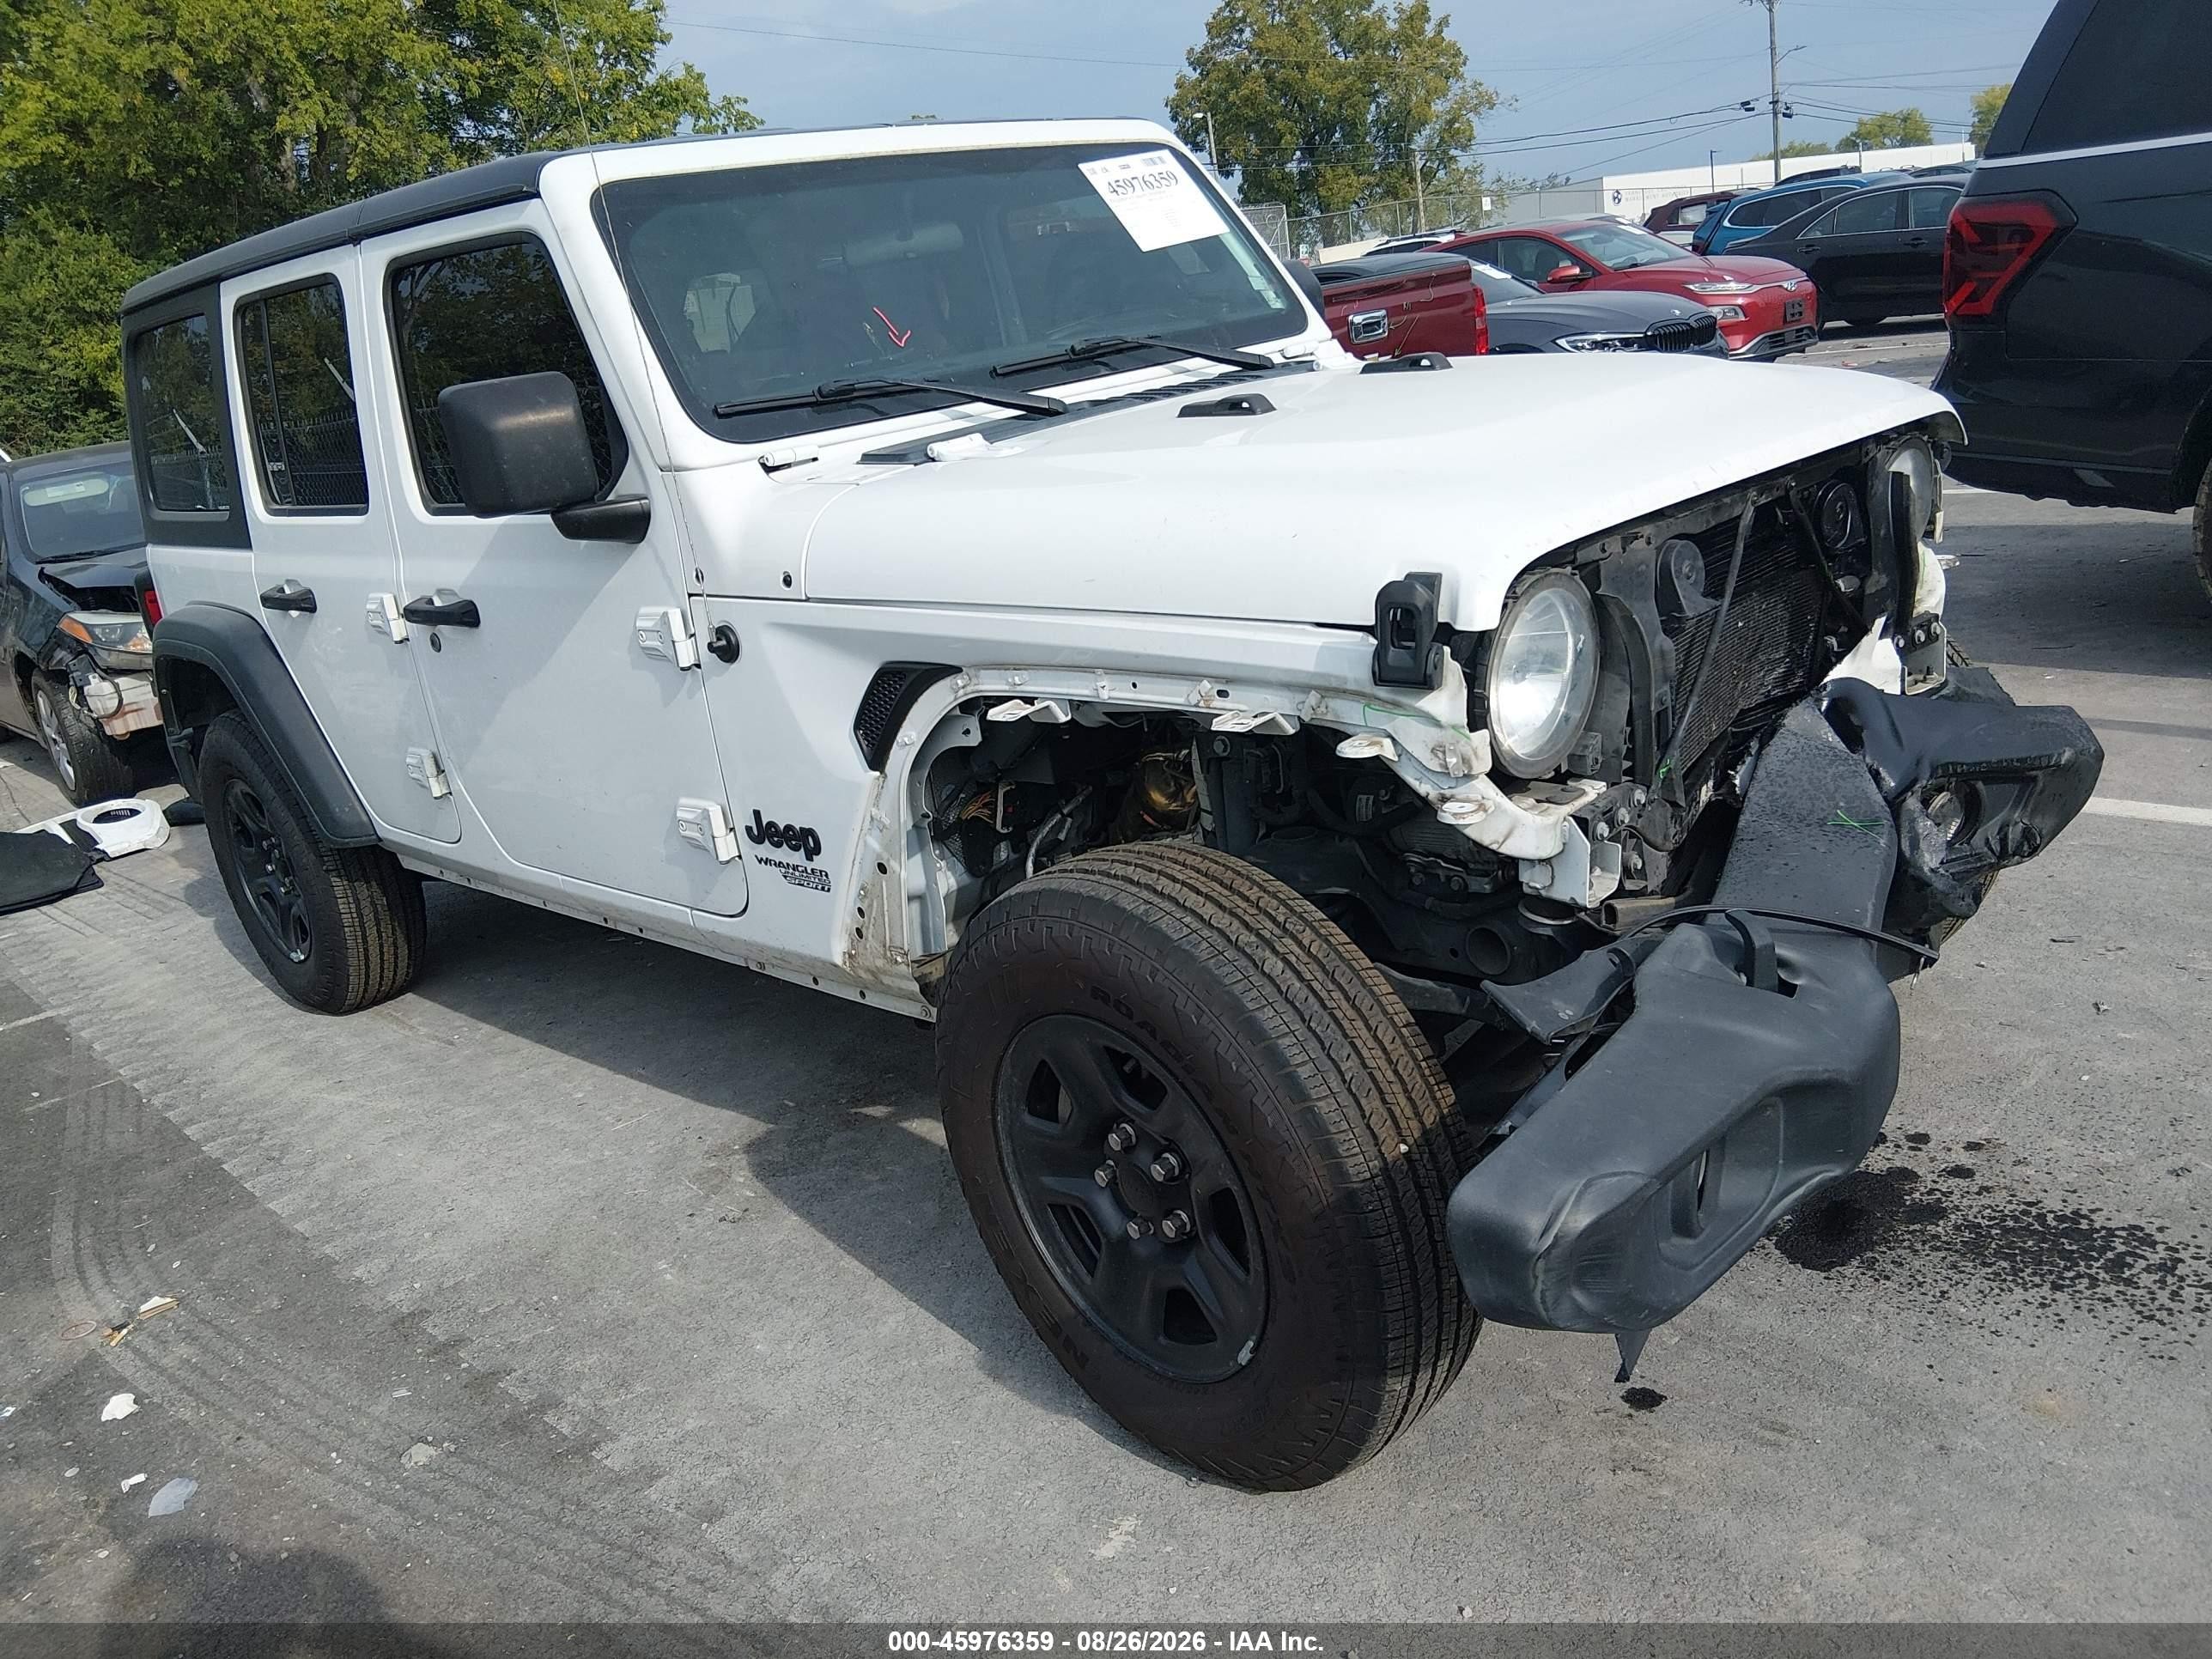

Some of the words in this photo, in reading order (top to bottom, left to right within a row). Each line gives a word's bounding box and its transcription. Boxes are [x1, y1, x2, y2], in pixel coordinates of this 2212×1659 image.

[1107, 171, 1179, 196] 45976359
[744, 809, 822, 862] Jeep
[754, 854, 830, 879] WRANGLER
[779, 869, 831, 884] UNLIMITED
[785, 877, 831, 892] SPORT
